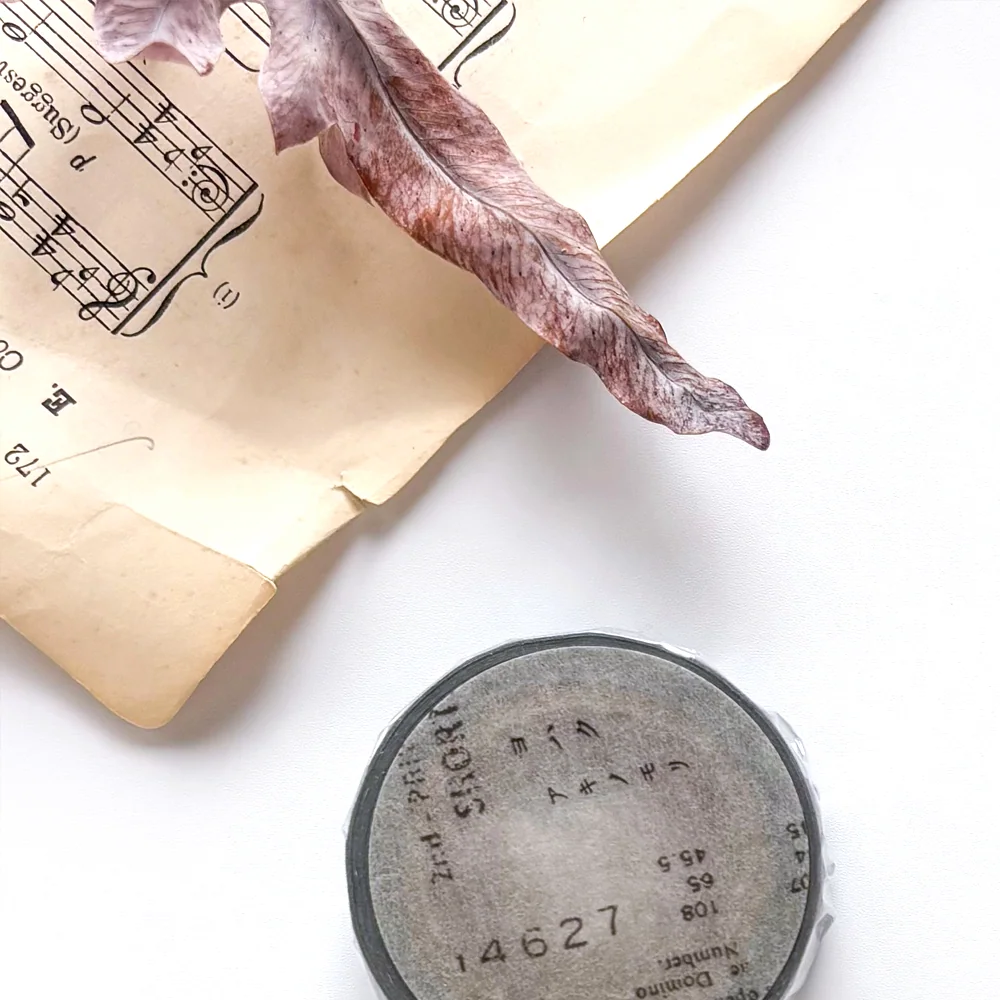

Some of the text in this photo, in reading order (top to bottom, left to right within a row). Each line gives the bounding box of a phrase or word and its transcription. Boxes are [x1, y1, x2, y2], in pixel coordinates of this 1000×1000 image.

[4, 443, 51, 487] 172
[656, 848, 706, 874] 45.5
[686, 871, 715, 893] 65
[679, 899, 720, 922] 108
[635, 970, 715, 1000] Domino
